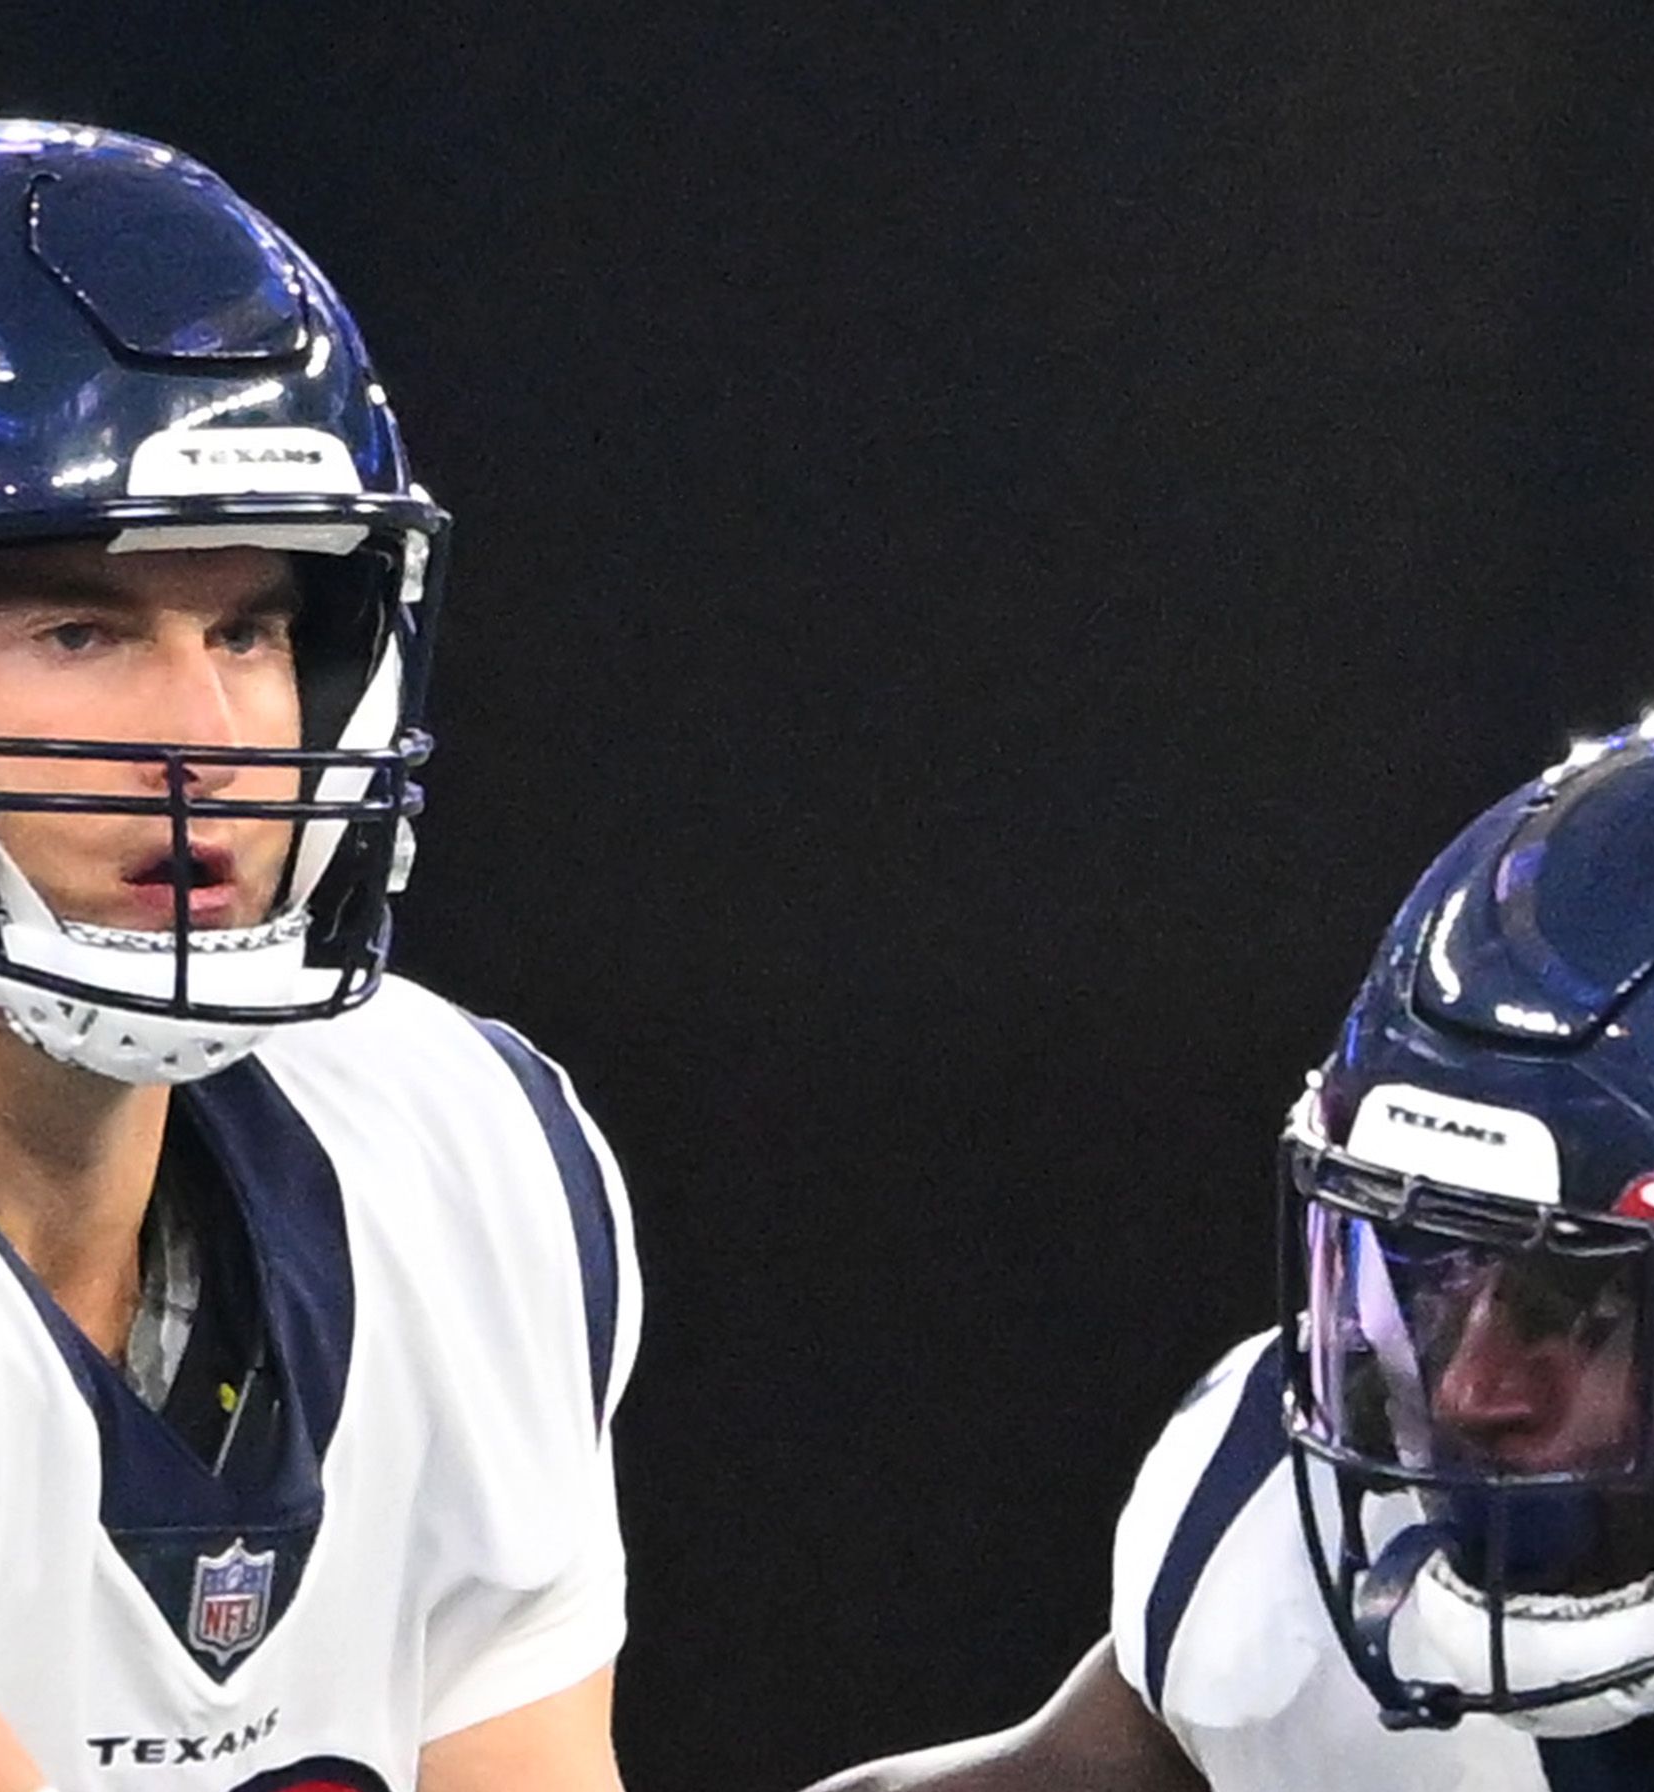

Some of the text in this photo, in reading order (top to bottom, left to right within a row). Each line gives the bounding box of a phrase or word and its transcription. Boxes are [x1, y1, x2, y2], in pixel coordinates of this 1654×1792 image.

[1386, 1103, 1508, 1146] TEXANS
[204, 1600, 256, 1641] NFL
[85, 1706, 280, 1767] TEXANS
